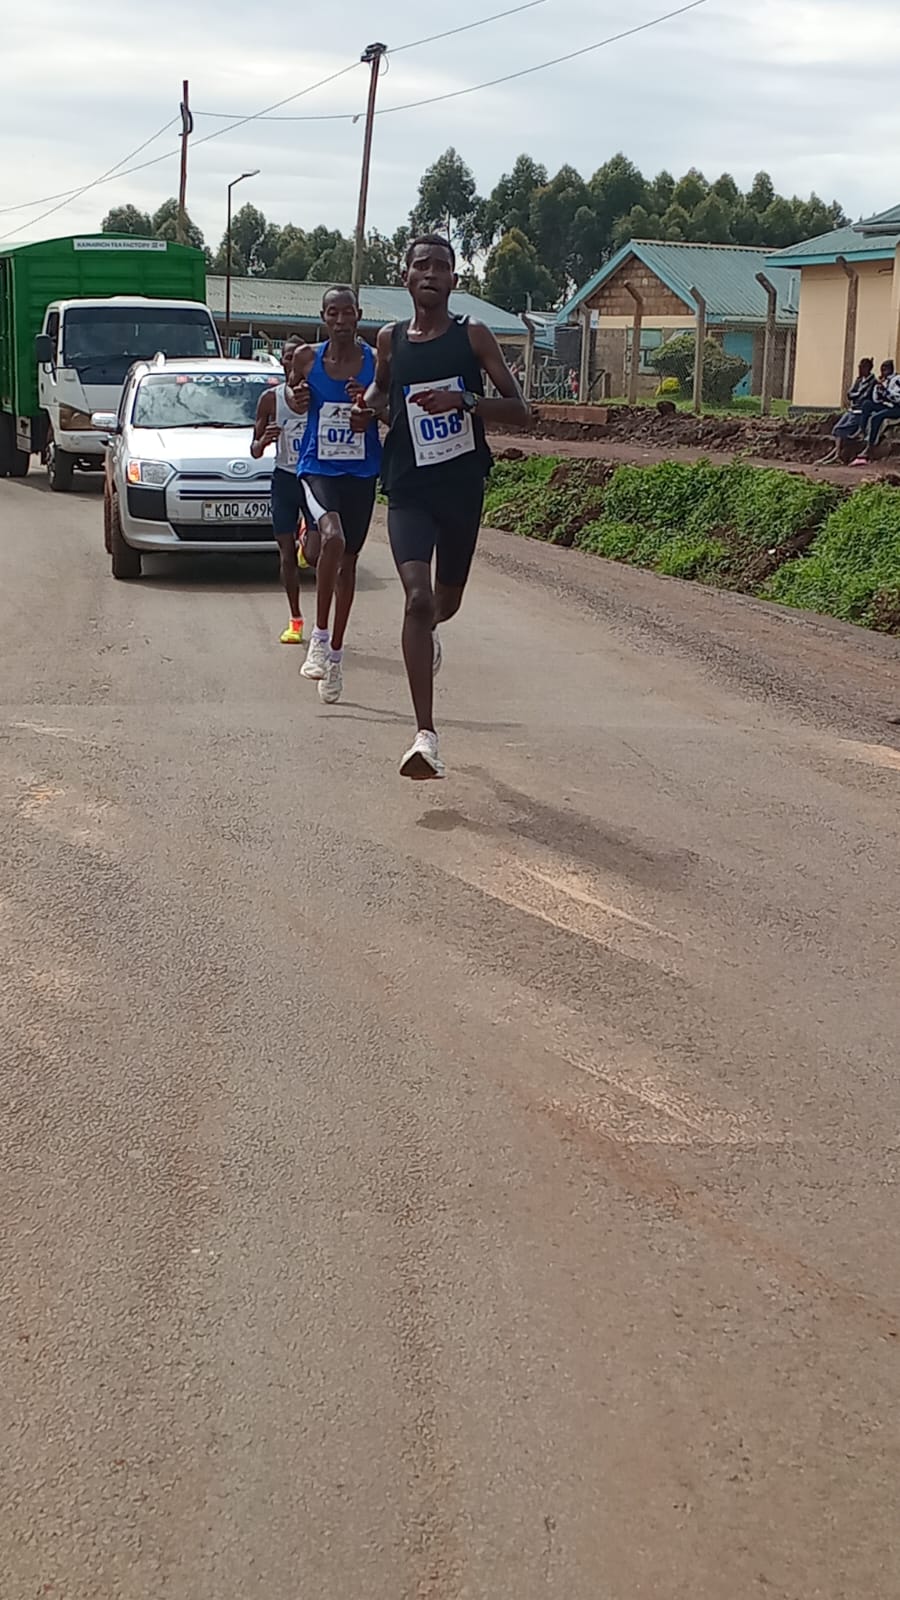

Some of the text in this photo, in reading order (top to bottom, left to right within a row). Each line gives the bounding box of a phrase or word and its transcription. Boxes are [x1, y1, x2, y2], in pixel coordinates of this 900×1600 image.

[193, 375, 265, 384] TOYOTA
[420, 412, 462, 441] 058
[327, 428, 355, 445] 072
[215, 503, 239, 517] KDQ
